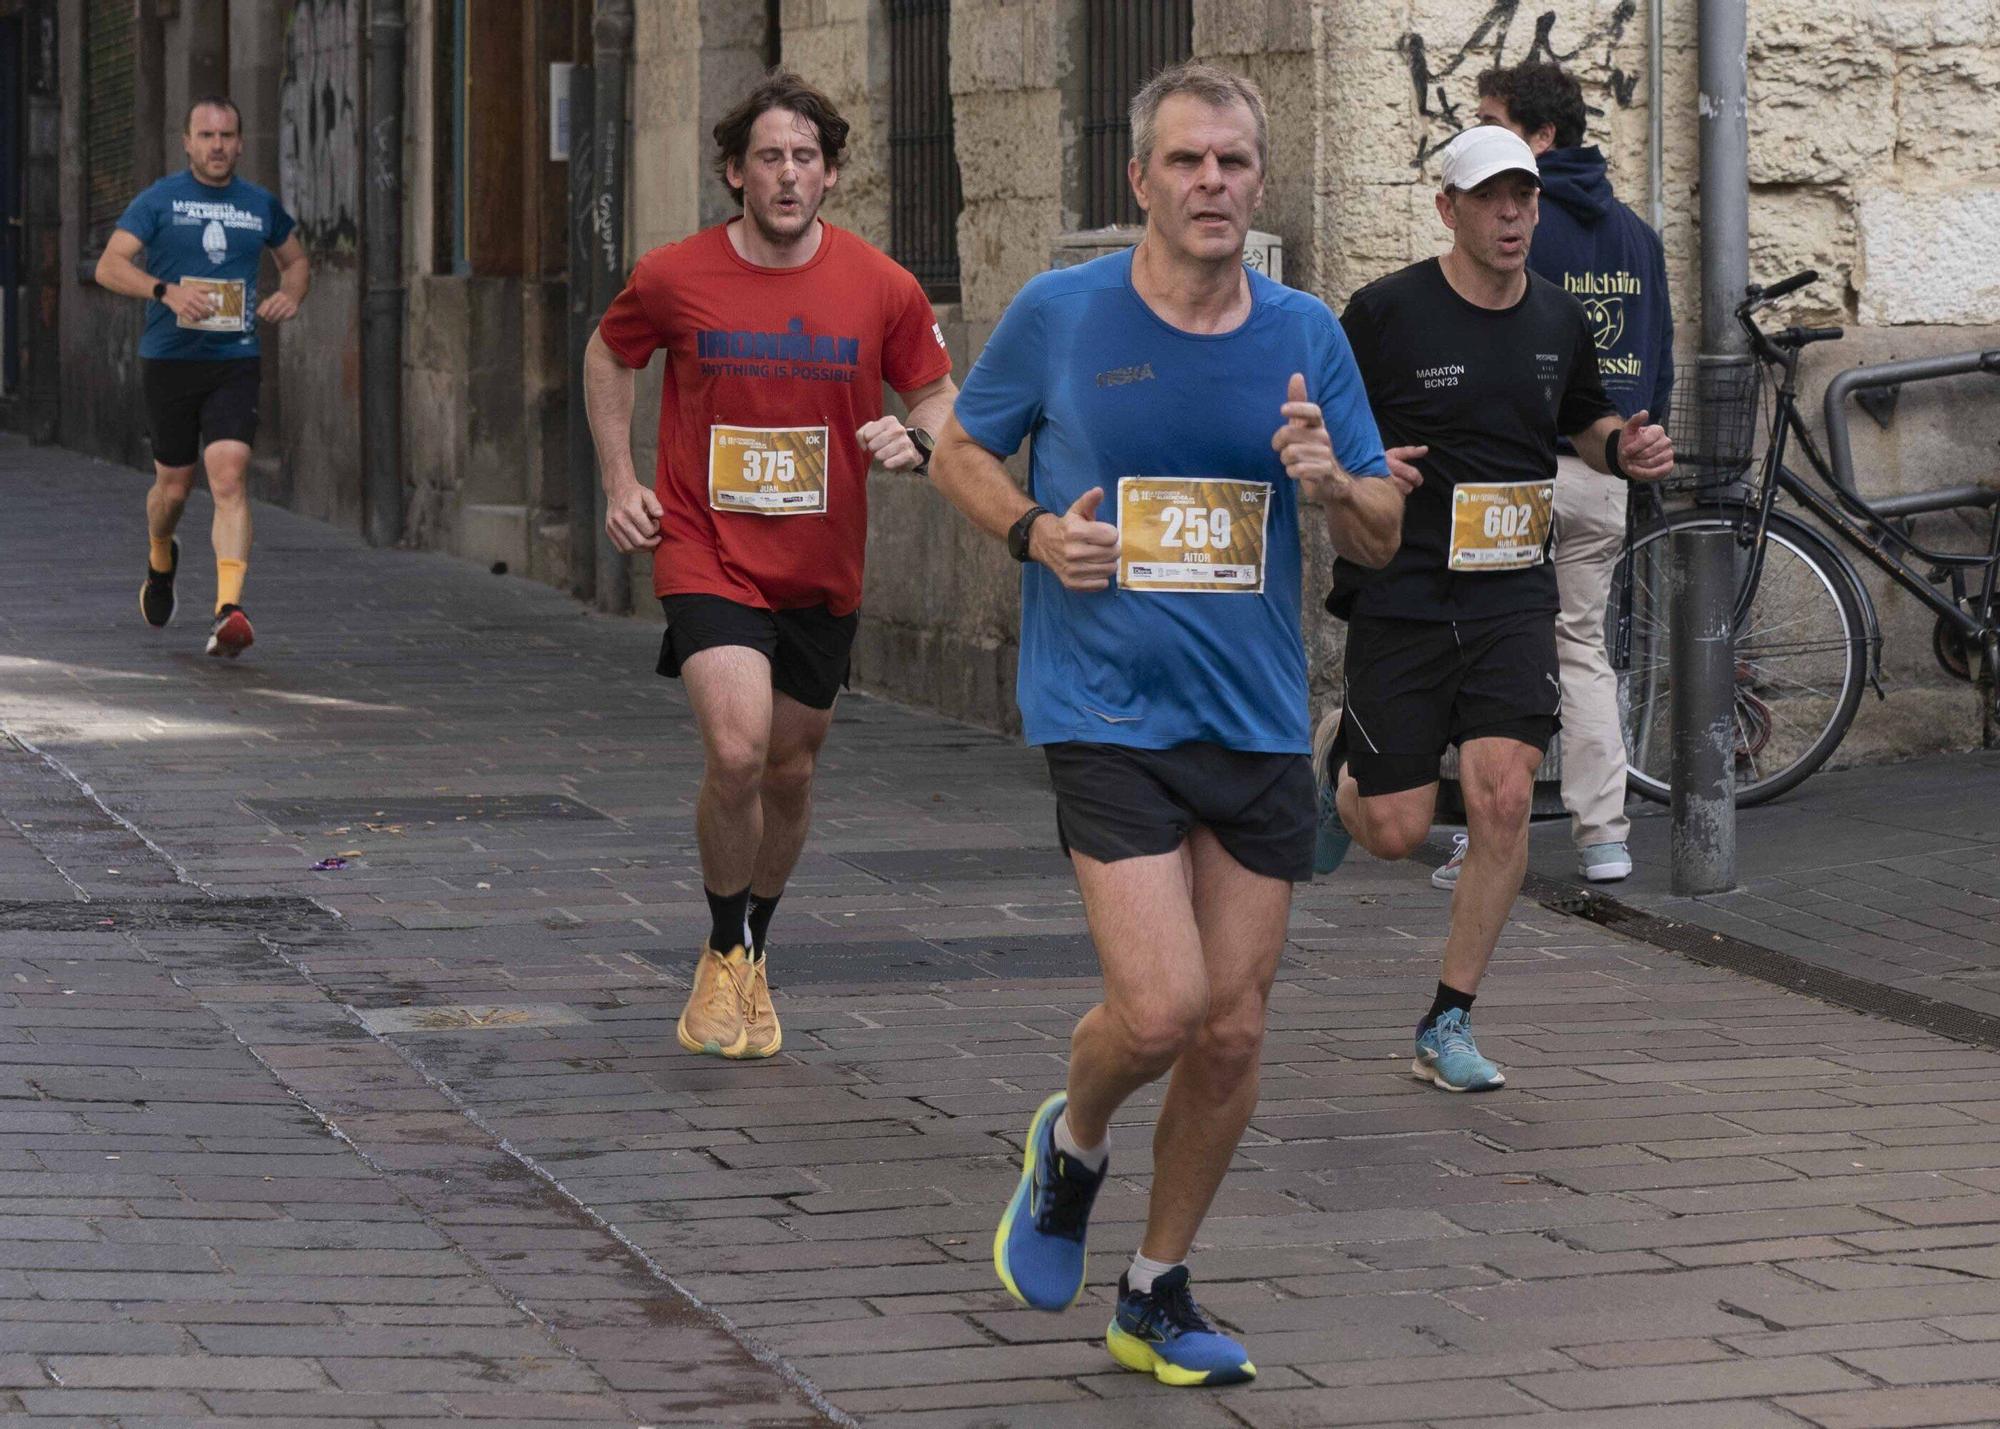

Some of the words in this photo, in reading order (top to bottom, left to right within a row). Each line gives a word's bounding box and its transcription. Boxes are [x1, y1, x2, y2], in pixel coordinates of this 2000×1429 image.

[697, 317, 860, 366] IRONMAN
[702, 362, 769, 379] ANYTHING
[773, 366, 787, 379] IS
[791, 366, 856, 384] POSSIBLE
[1416, 364, 1465, 379] MARATÓN
[805, 435, 820, 445] 10K
[742, 450, 795, 482] 375
[760, 483, 779, 493] JUAN
[1240, 490, 1258, 503] 10K
[1160, 506, 1231, 549] 259
[1483, 503, 1532, 538] 602
[1183, 552, 1211, 563] AITOR
